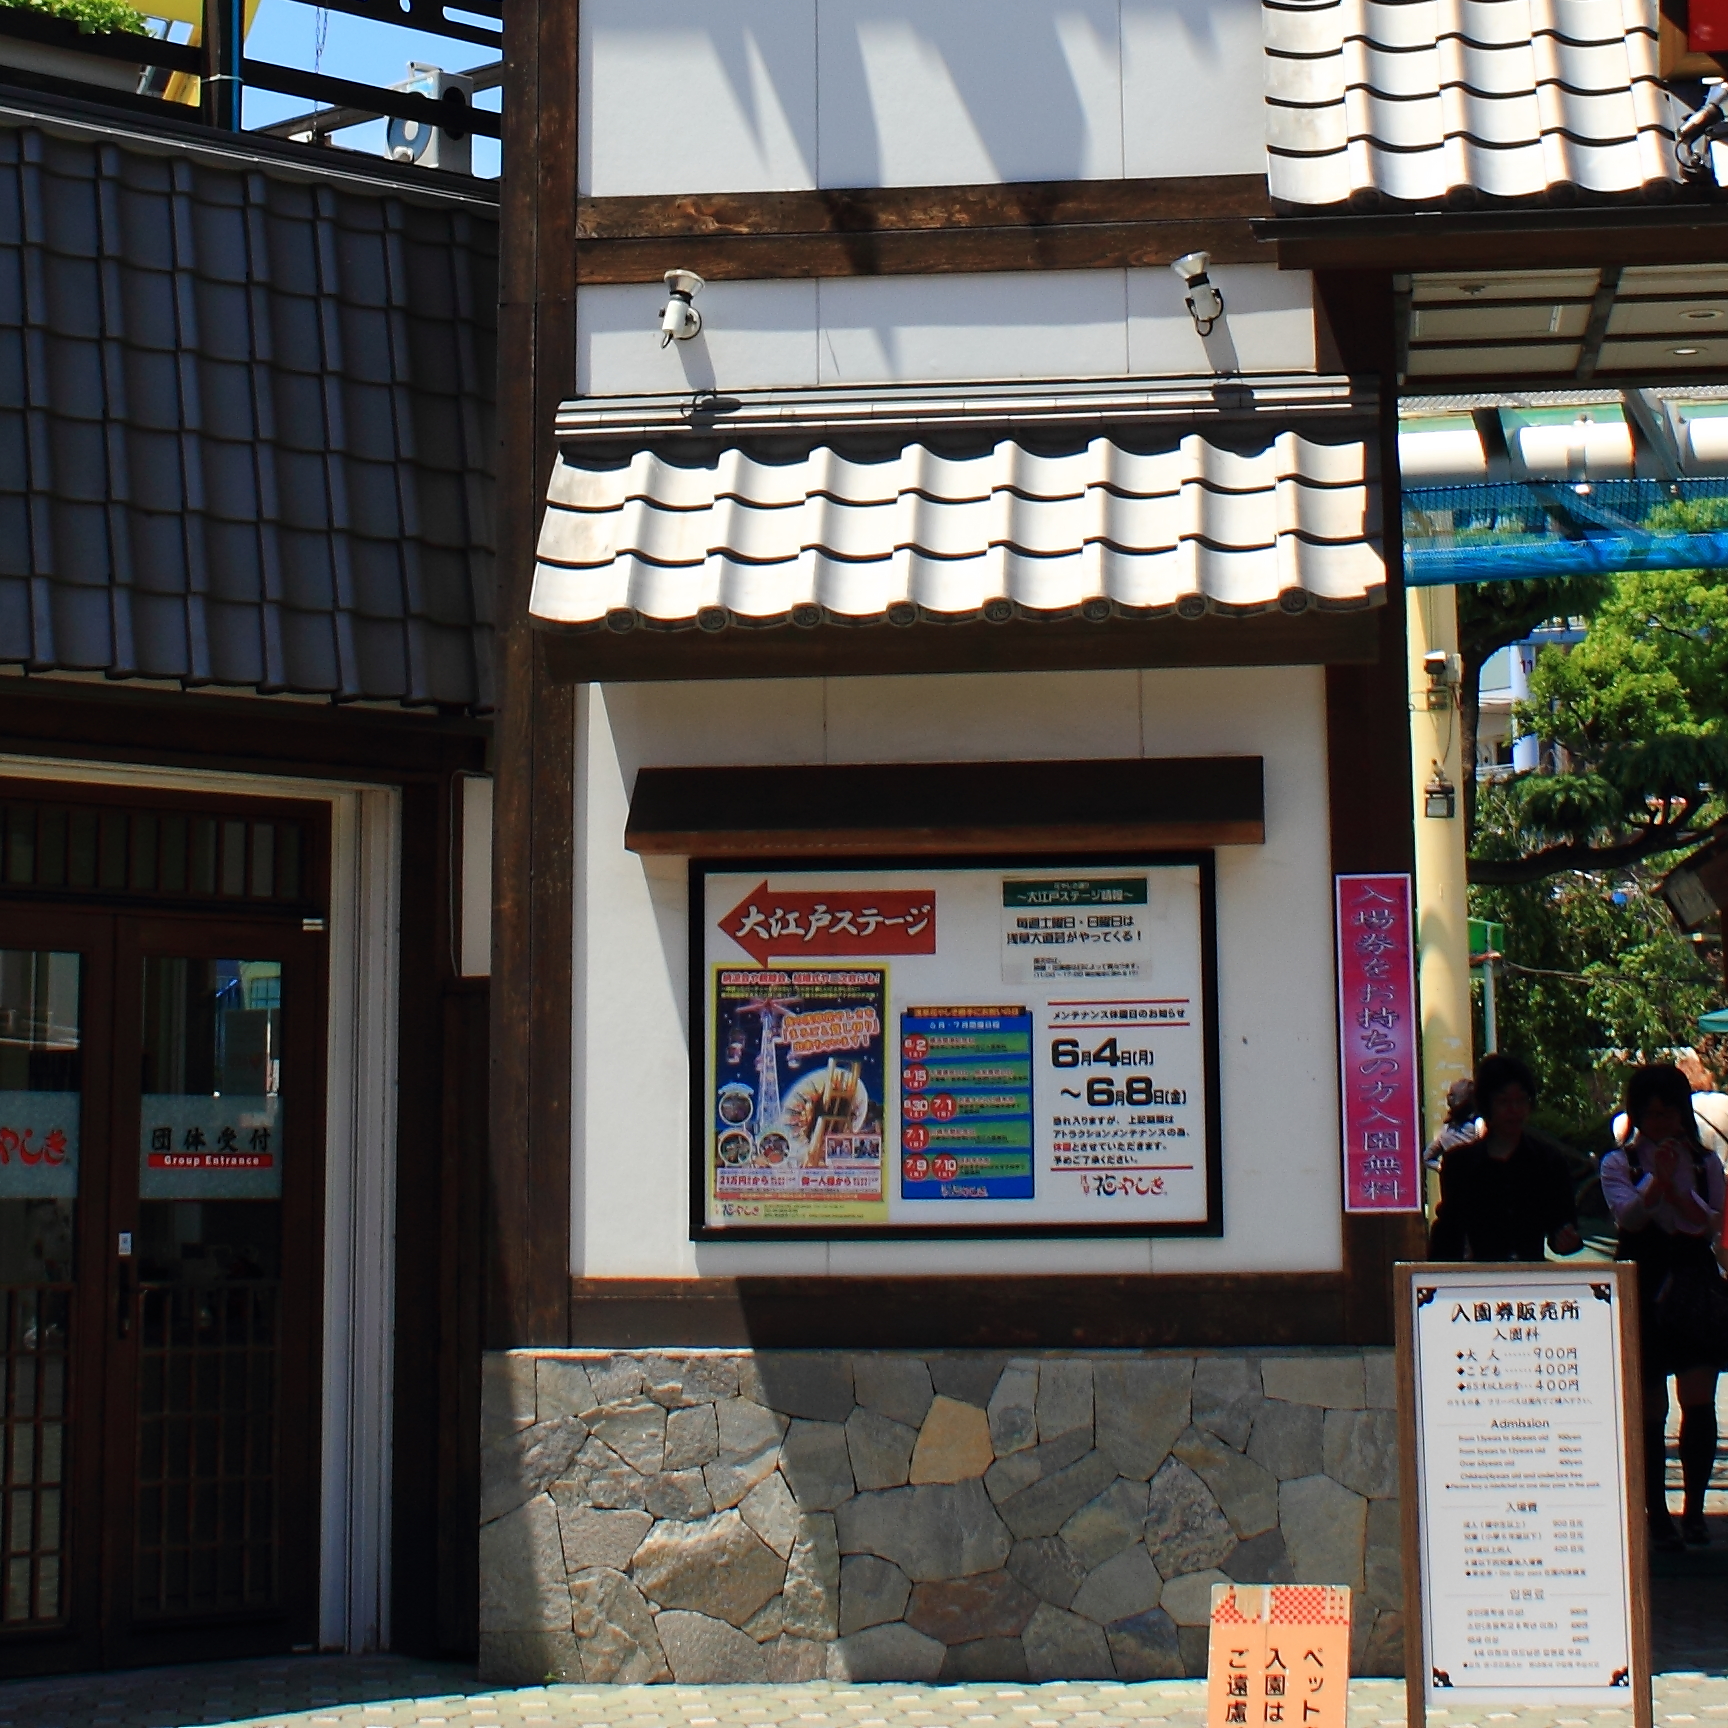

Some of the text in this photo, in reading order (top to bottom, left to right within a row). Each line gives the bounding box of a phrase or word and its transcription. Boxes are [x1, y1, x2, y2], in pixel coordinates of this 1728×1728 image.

[735, 903, 932, 942] 大江戸ステージ
[151, 1127, 271, 1152] 団体受付
[164, 1156, 260, 1167] Group Entrance
[1451, 1299, 1580, 1322] 入園券販売所
[1493, 1326, 1540, 1342] 入園料
[1491, 1419, 1550, 1430] Admission
